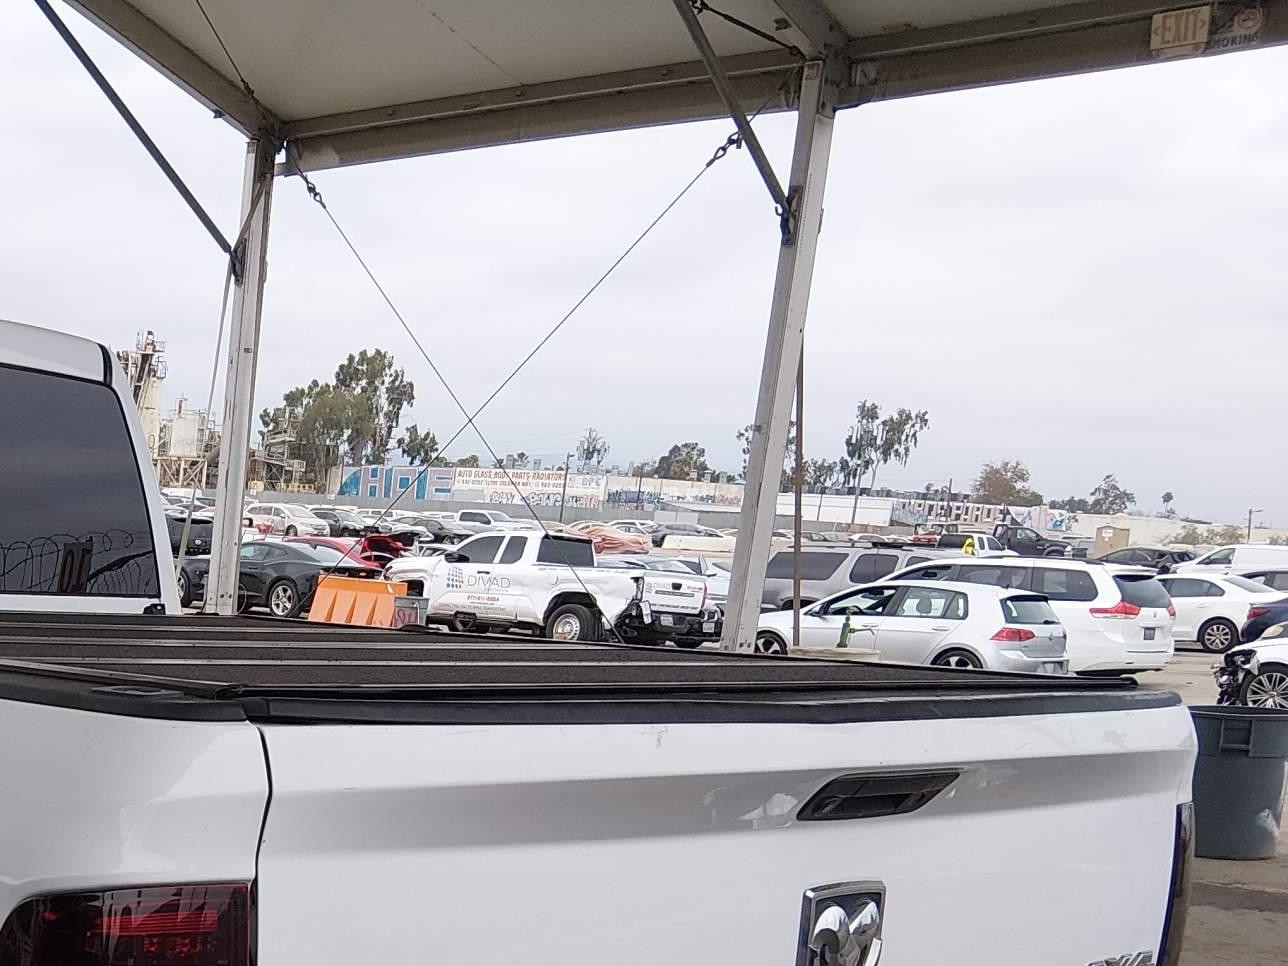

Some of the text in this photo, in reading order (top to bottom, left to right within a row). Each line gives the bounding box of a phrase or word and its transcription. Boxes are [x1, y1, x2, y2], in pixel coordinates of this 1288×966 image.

[1160, 10, 1201, 45] EXIT
[457, 470, 472, 478] AUTO
[467, 575, 511, 589] DIVAD
